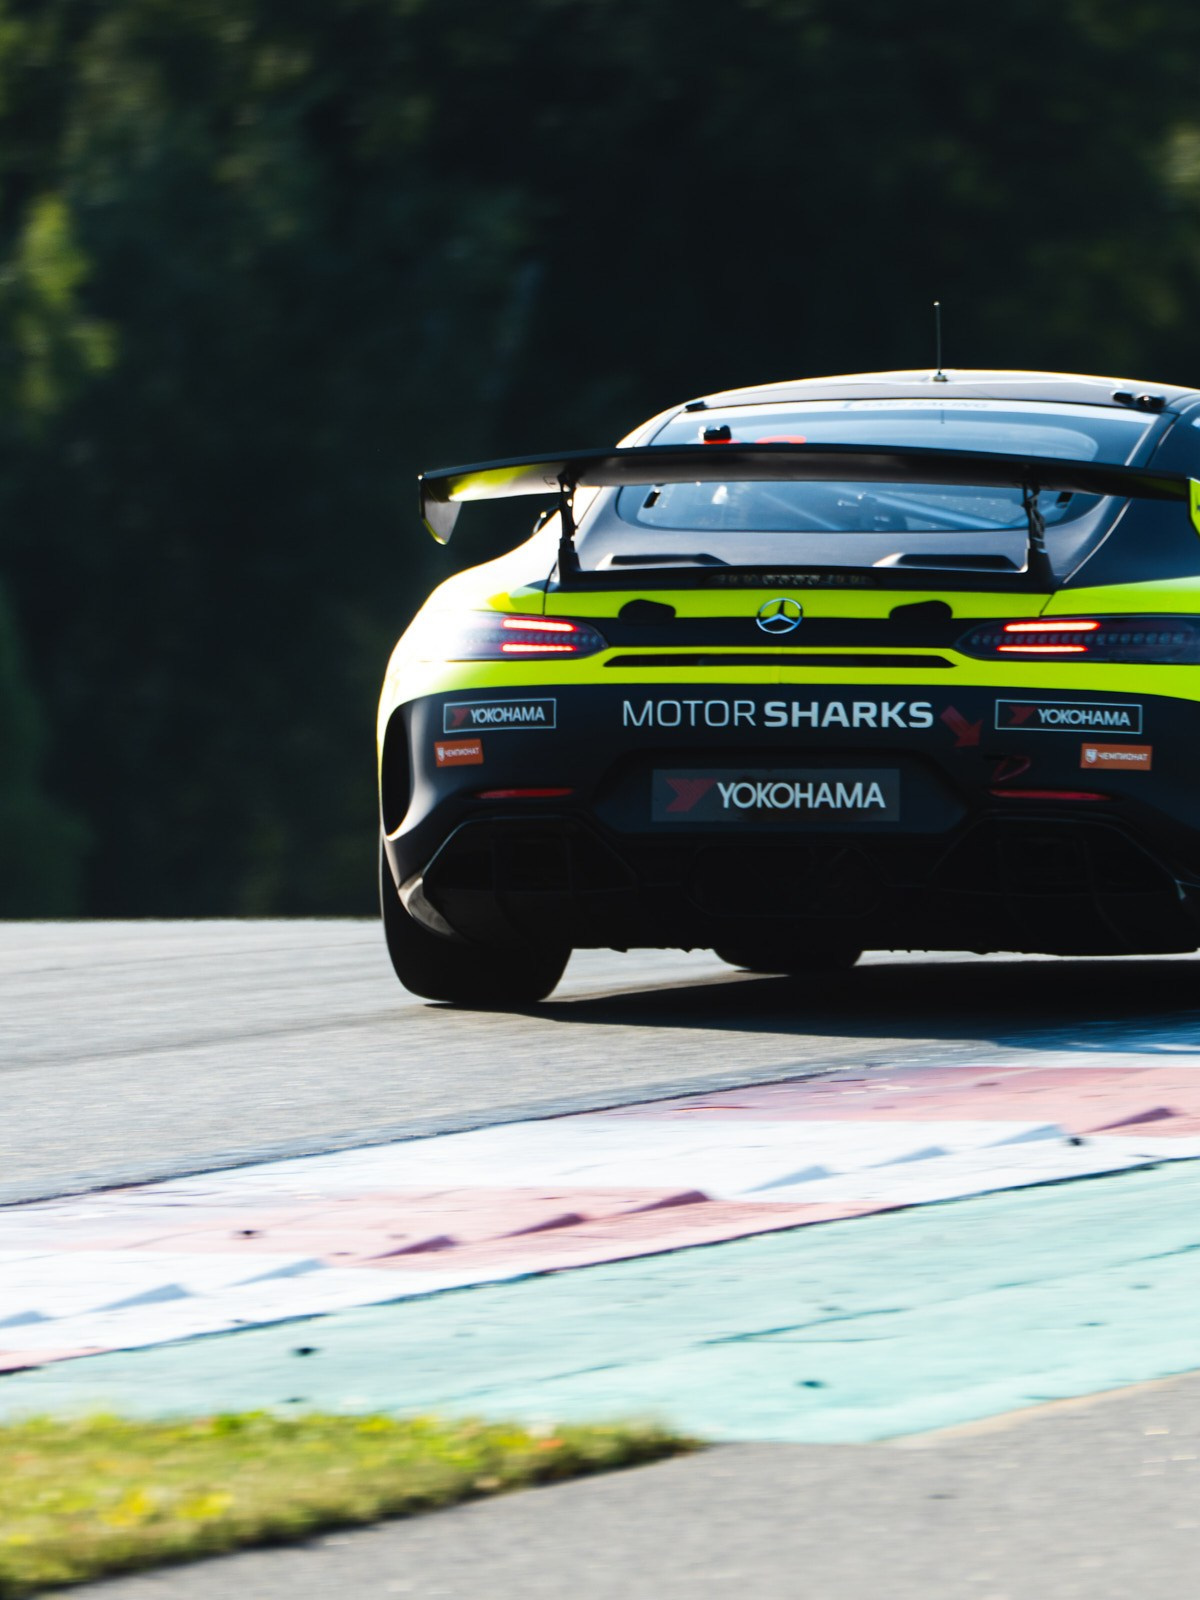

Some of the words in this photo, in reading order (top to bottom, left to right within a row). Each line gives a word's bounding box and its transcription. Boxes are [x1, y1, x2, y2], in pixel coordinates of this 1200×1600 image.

[470, 706, 545, 724] YOKOHAMA
[622, 700, 757, 727] MOTOR
[763, 701, 934, 728] SHARKS
[1038, 708, 1131, 727] YOKOHAMA
[717, 782, 887, 809] YOKOHAMA
